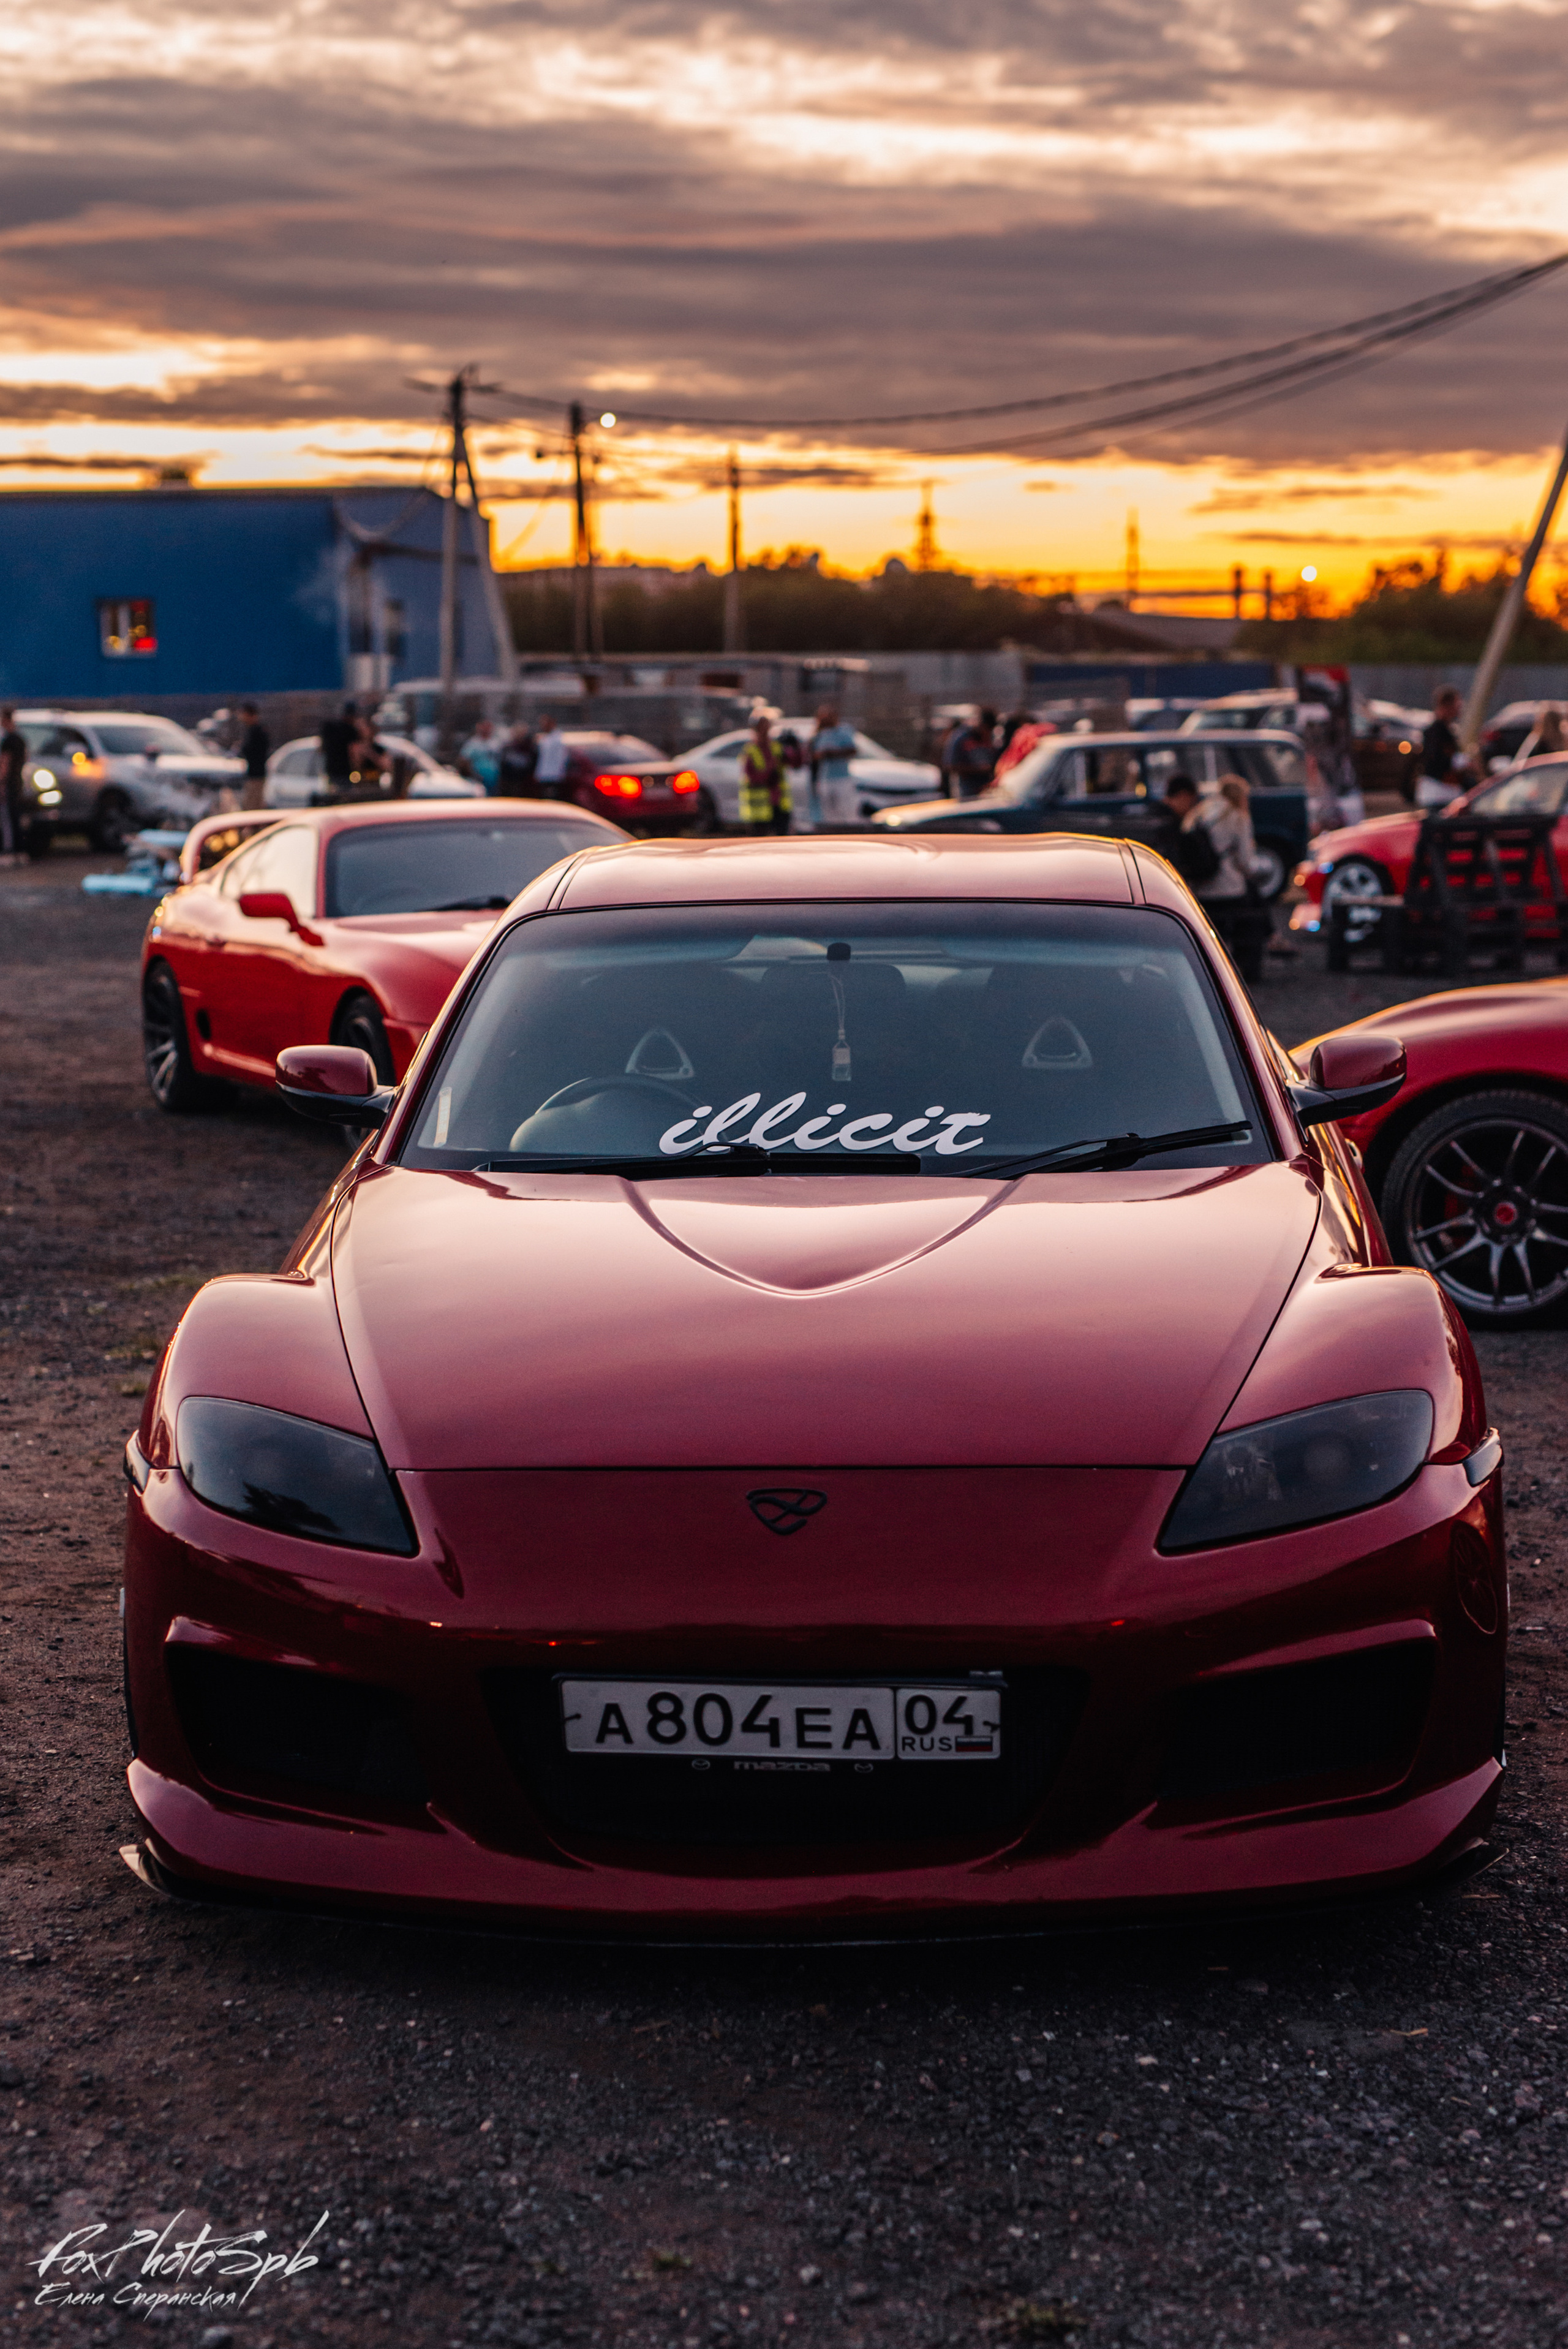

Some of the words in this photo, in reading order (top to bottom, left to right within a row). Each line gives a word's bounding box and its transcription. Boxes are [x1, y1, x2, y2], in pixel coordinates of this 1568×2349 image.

[658, 1092, 991, 1155] illicit
[905, 1694, 974, 1735] 04
[902, 1736, 953, 1752] RUS
